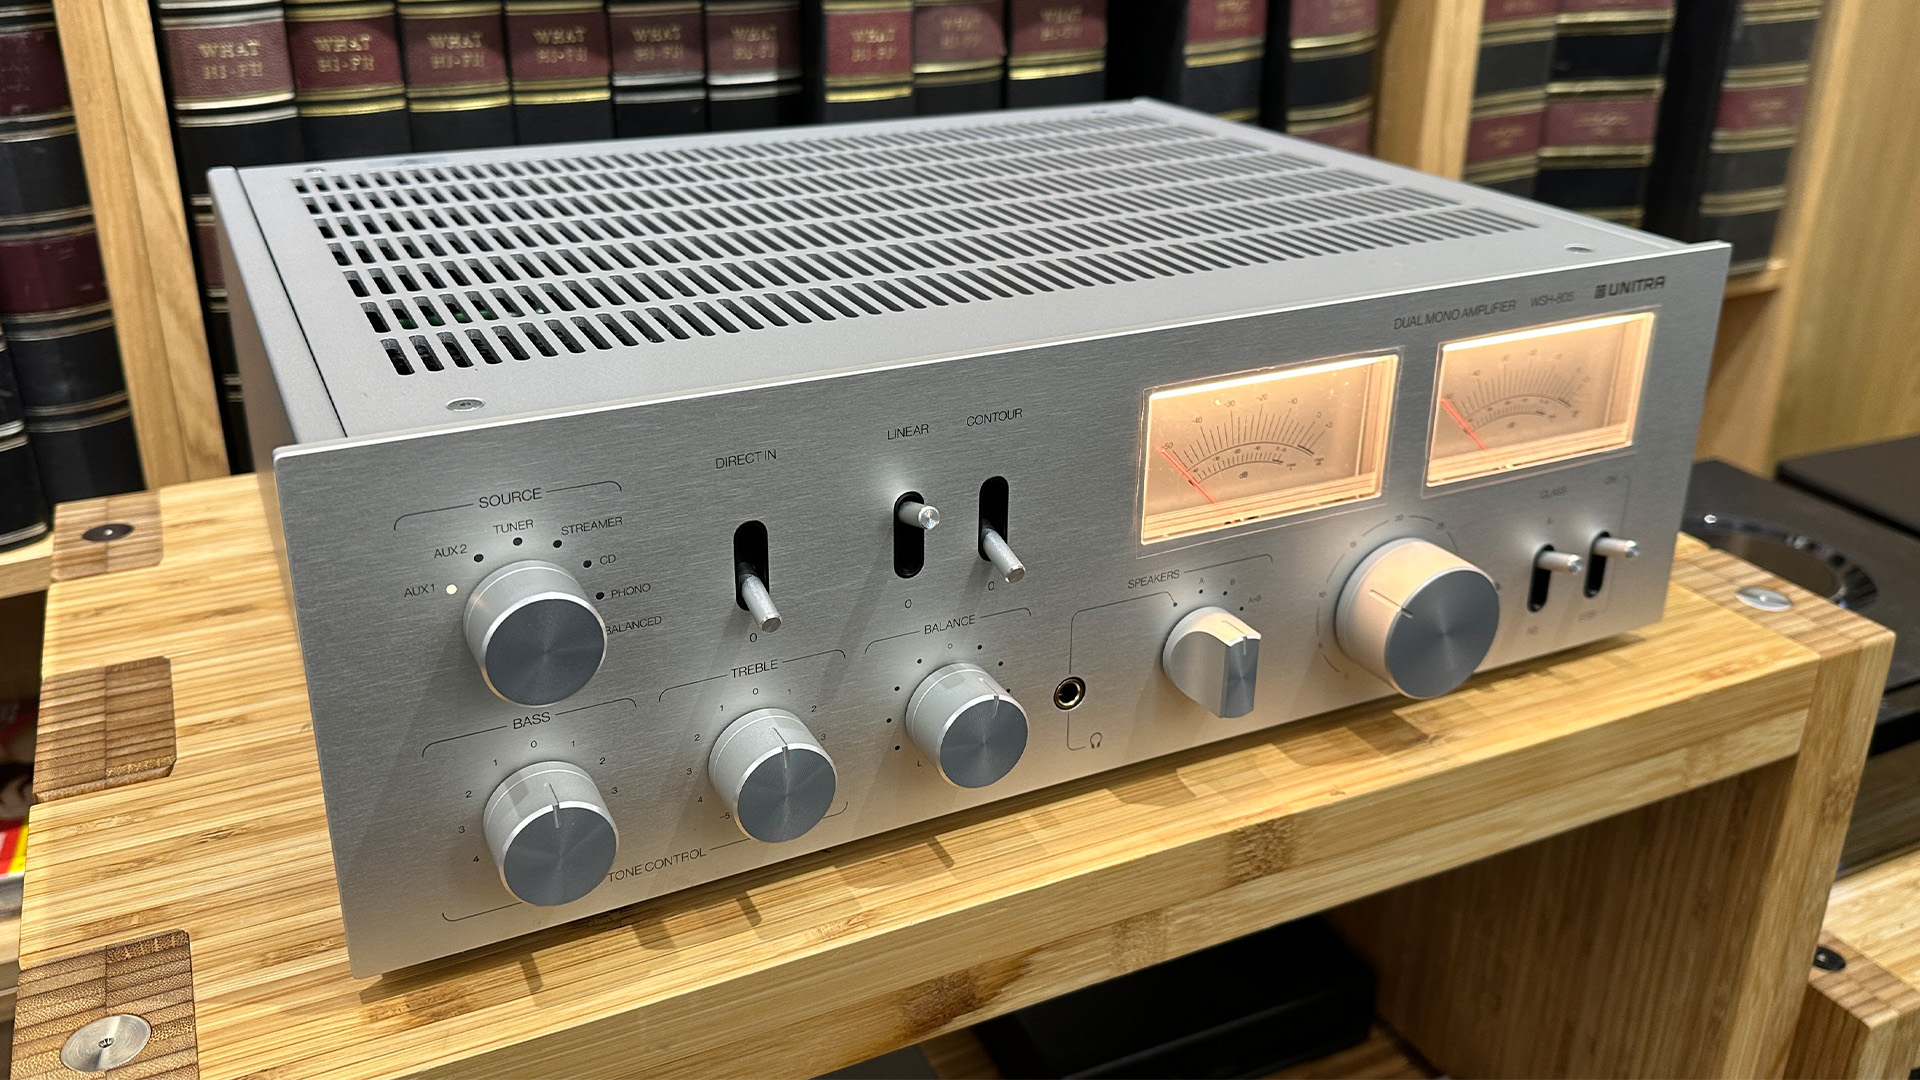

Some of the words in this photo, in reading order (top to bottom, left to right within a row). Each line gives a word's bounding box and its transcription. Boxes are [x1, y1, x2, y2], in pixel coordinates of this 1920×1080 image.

[198, 39, 260, 58] WHAT
[312, 34, 372, 52] WHAT
[427, 31, 482, 49] WHAT
[1608, 275, 1666, 297] UNITRA
[1394, 317, 1423, 330] DUAL
[1425, 308, 1460, 325] MONO
[1461, 300, 1517, 319] AMPLIFIER
[966, 408, 1024, 427] CONTOUR
[887, 423, 930, 441] LINEAR
[715, 450, 763, 470] DIRECT
[764, 449, 778, 461] IN
[478, 487, 543, 509] SOURCE
[492, 519, 535, 535] TUNER
[561, 516, 624, 536] STREAMER
[599, 554, 618, 566] CD
[1127, 569, 1181, 589] SPEAKERS
[610, 583, 652, 599] PHONO
[924, 614, 977, 635] BALANCE
[731, 659, 779, 679] TREBLE
[811, 704, 818, 713] 2
[512, 711, 552, 730] BASS
[694, 733, 701, 742] 2
[820, 733, 827, 741] 3
[599, 757, 606, 766] 2
[686, 767, 693, 776] 3
[465, 789, 473, 799] 2
[611, 786, 619, 795] 3
[697, 796, 703, 804] 4
[458, 825, 466, 834] 3
[473, 855, 480, 864] 4
[608, 864, 643, 882] TONE
[644, 847, 708, 872] CONTROL
